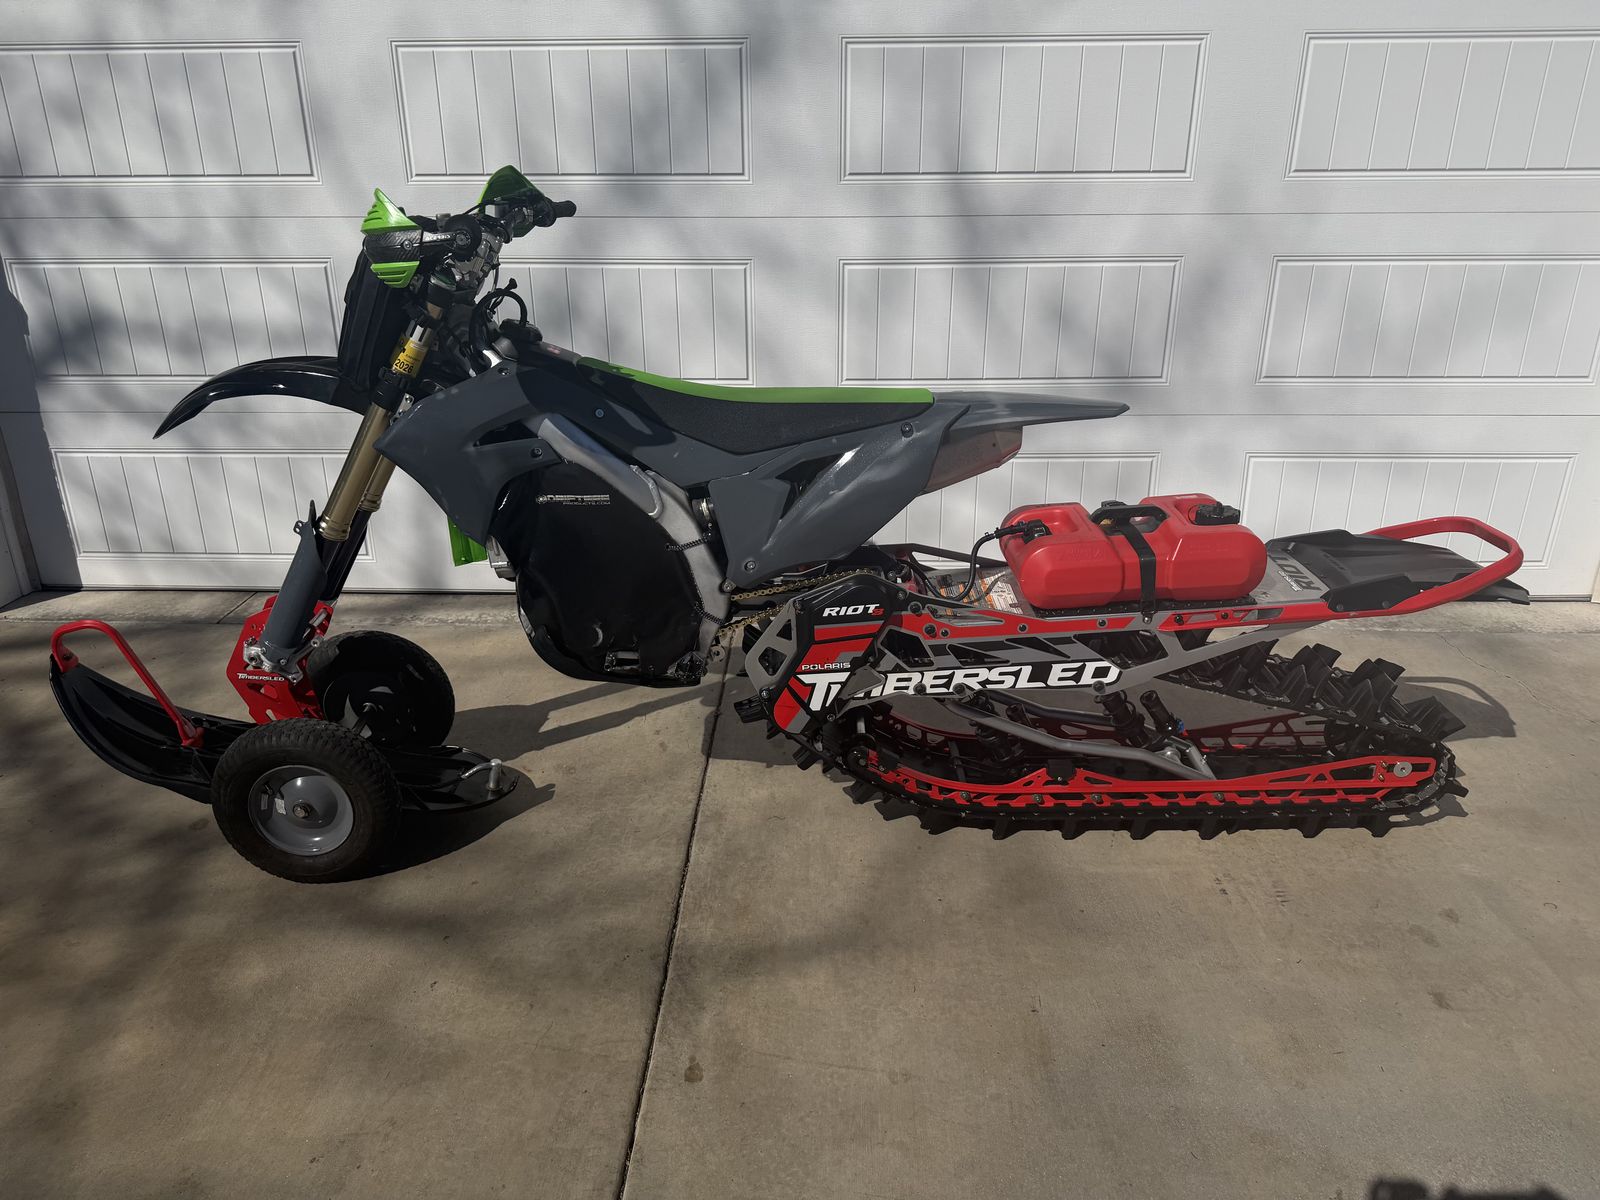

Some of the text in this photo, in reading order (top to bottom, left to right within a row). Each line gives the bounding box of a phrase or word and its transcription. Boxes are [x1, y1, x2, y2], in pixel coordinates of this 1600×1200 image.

[395, 359, 414, 373] 2026
[822, 603, 880, 617] RIOT
[801, 662, 851, 671] POLARIS
[237, 673, 284, 682] TIMBERSLED
